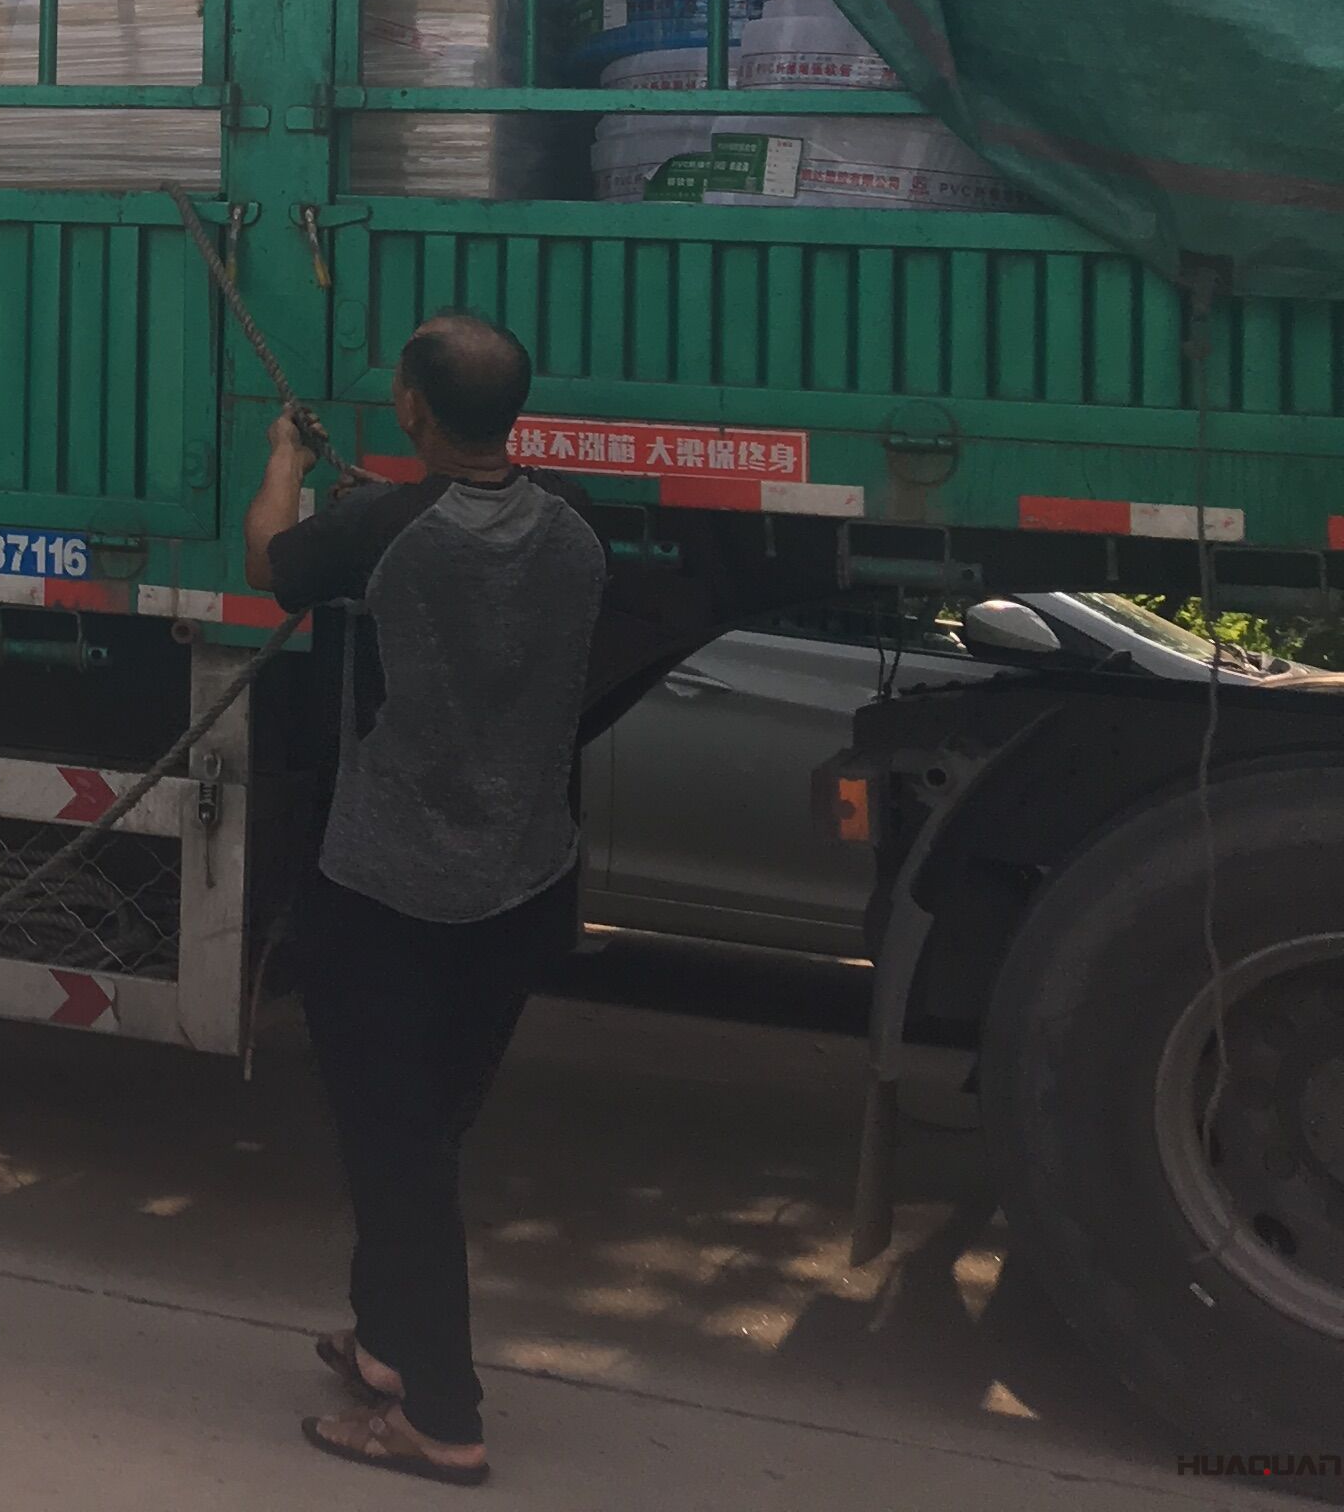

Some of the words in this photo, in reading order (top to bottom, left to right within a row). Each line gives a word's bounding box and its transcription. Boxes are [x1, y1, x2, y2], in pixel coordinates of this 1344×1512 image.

[644, 436, 798, 474] 大梁保终身
